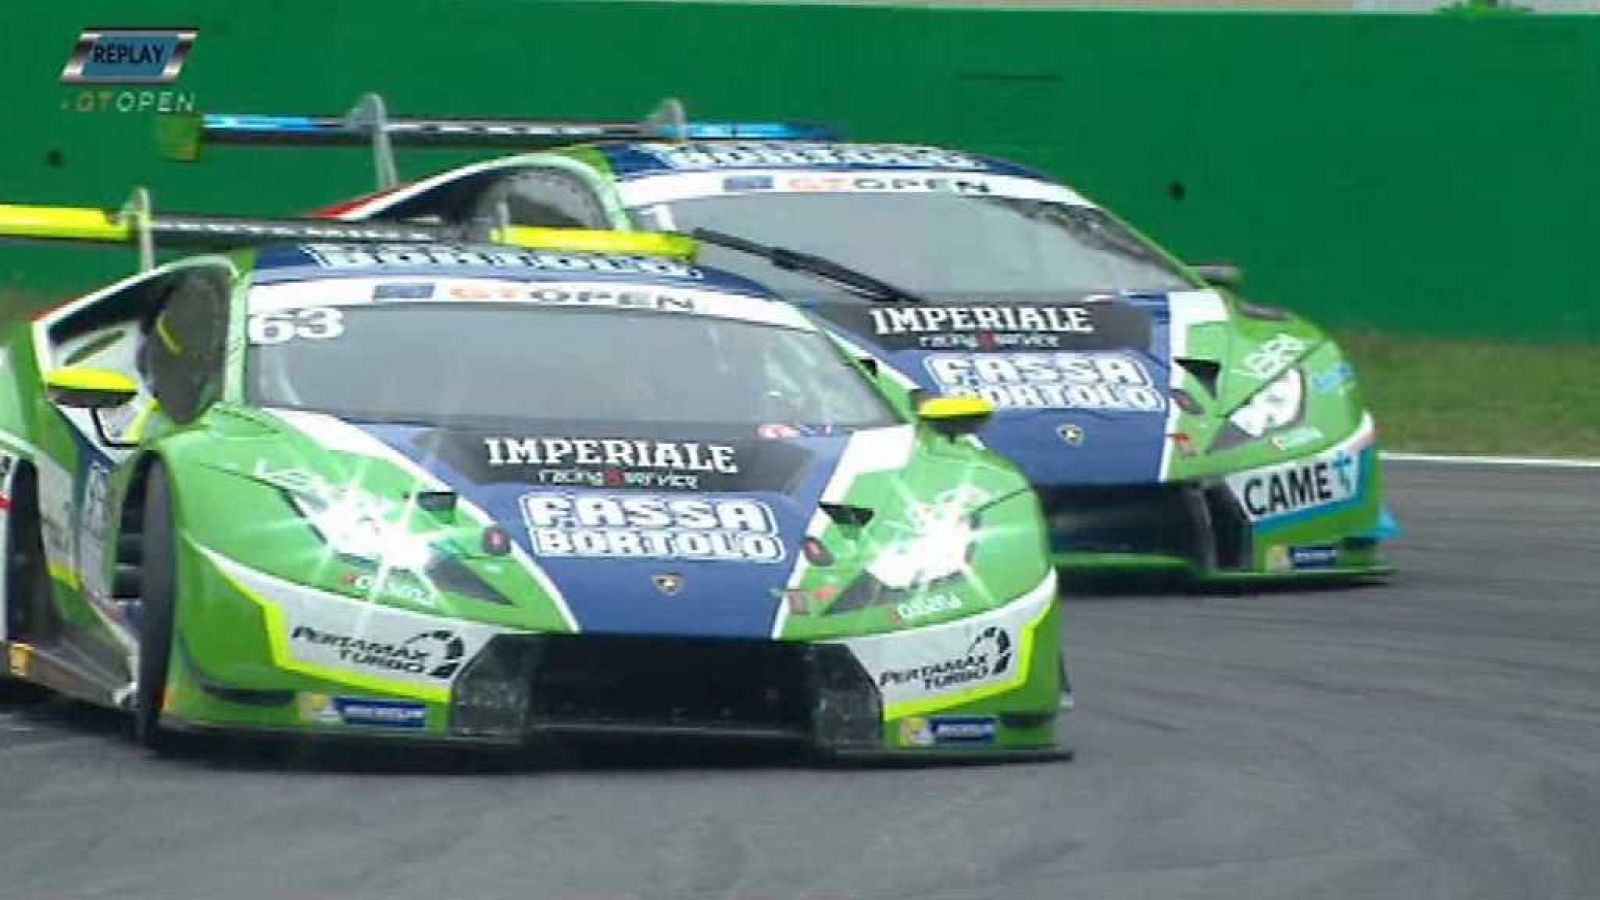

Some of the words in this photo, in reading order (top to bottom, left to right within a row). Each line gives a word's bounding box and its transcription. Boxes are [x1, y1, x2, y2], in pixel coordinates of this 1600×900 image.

[248, 307, 344, 345] 63
[869, 306, 1093, 334] IMPERIALE
[926, 354, 1150, 387] FASSA
[485, 437, 737, 474] IMPERIALE
[1244, 463, 1332, 516] CAME
[522, 493, 778, 533] FASSA
[536, 526, 784, 563] BORTOLO
[880, 654, 988, 686] PERTAMAX
[924, 667, 988, 689] TURBO
